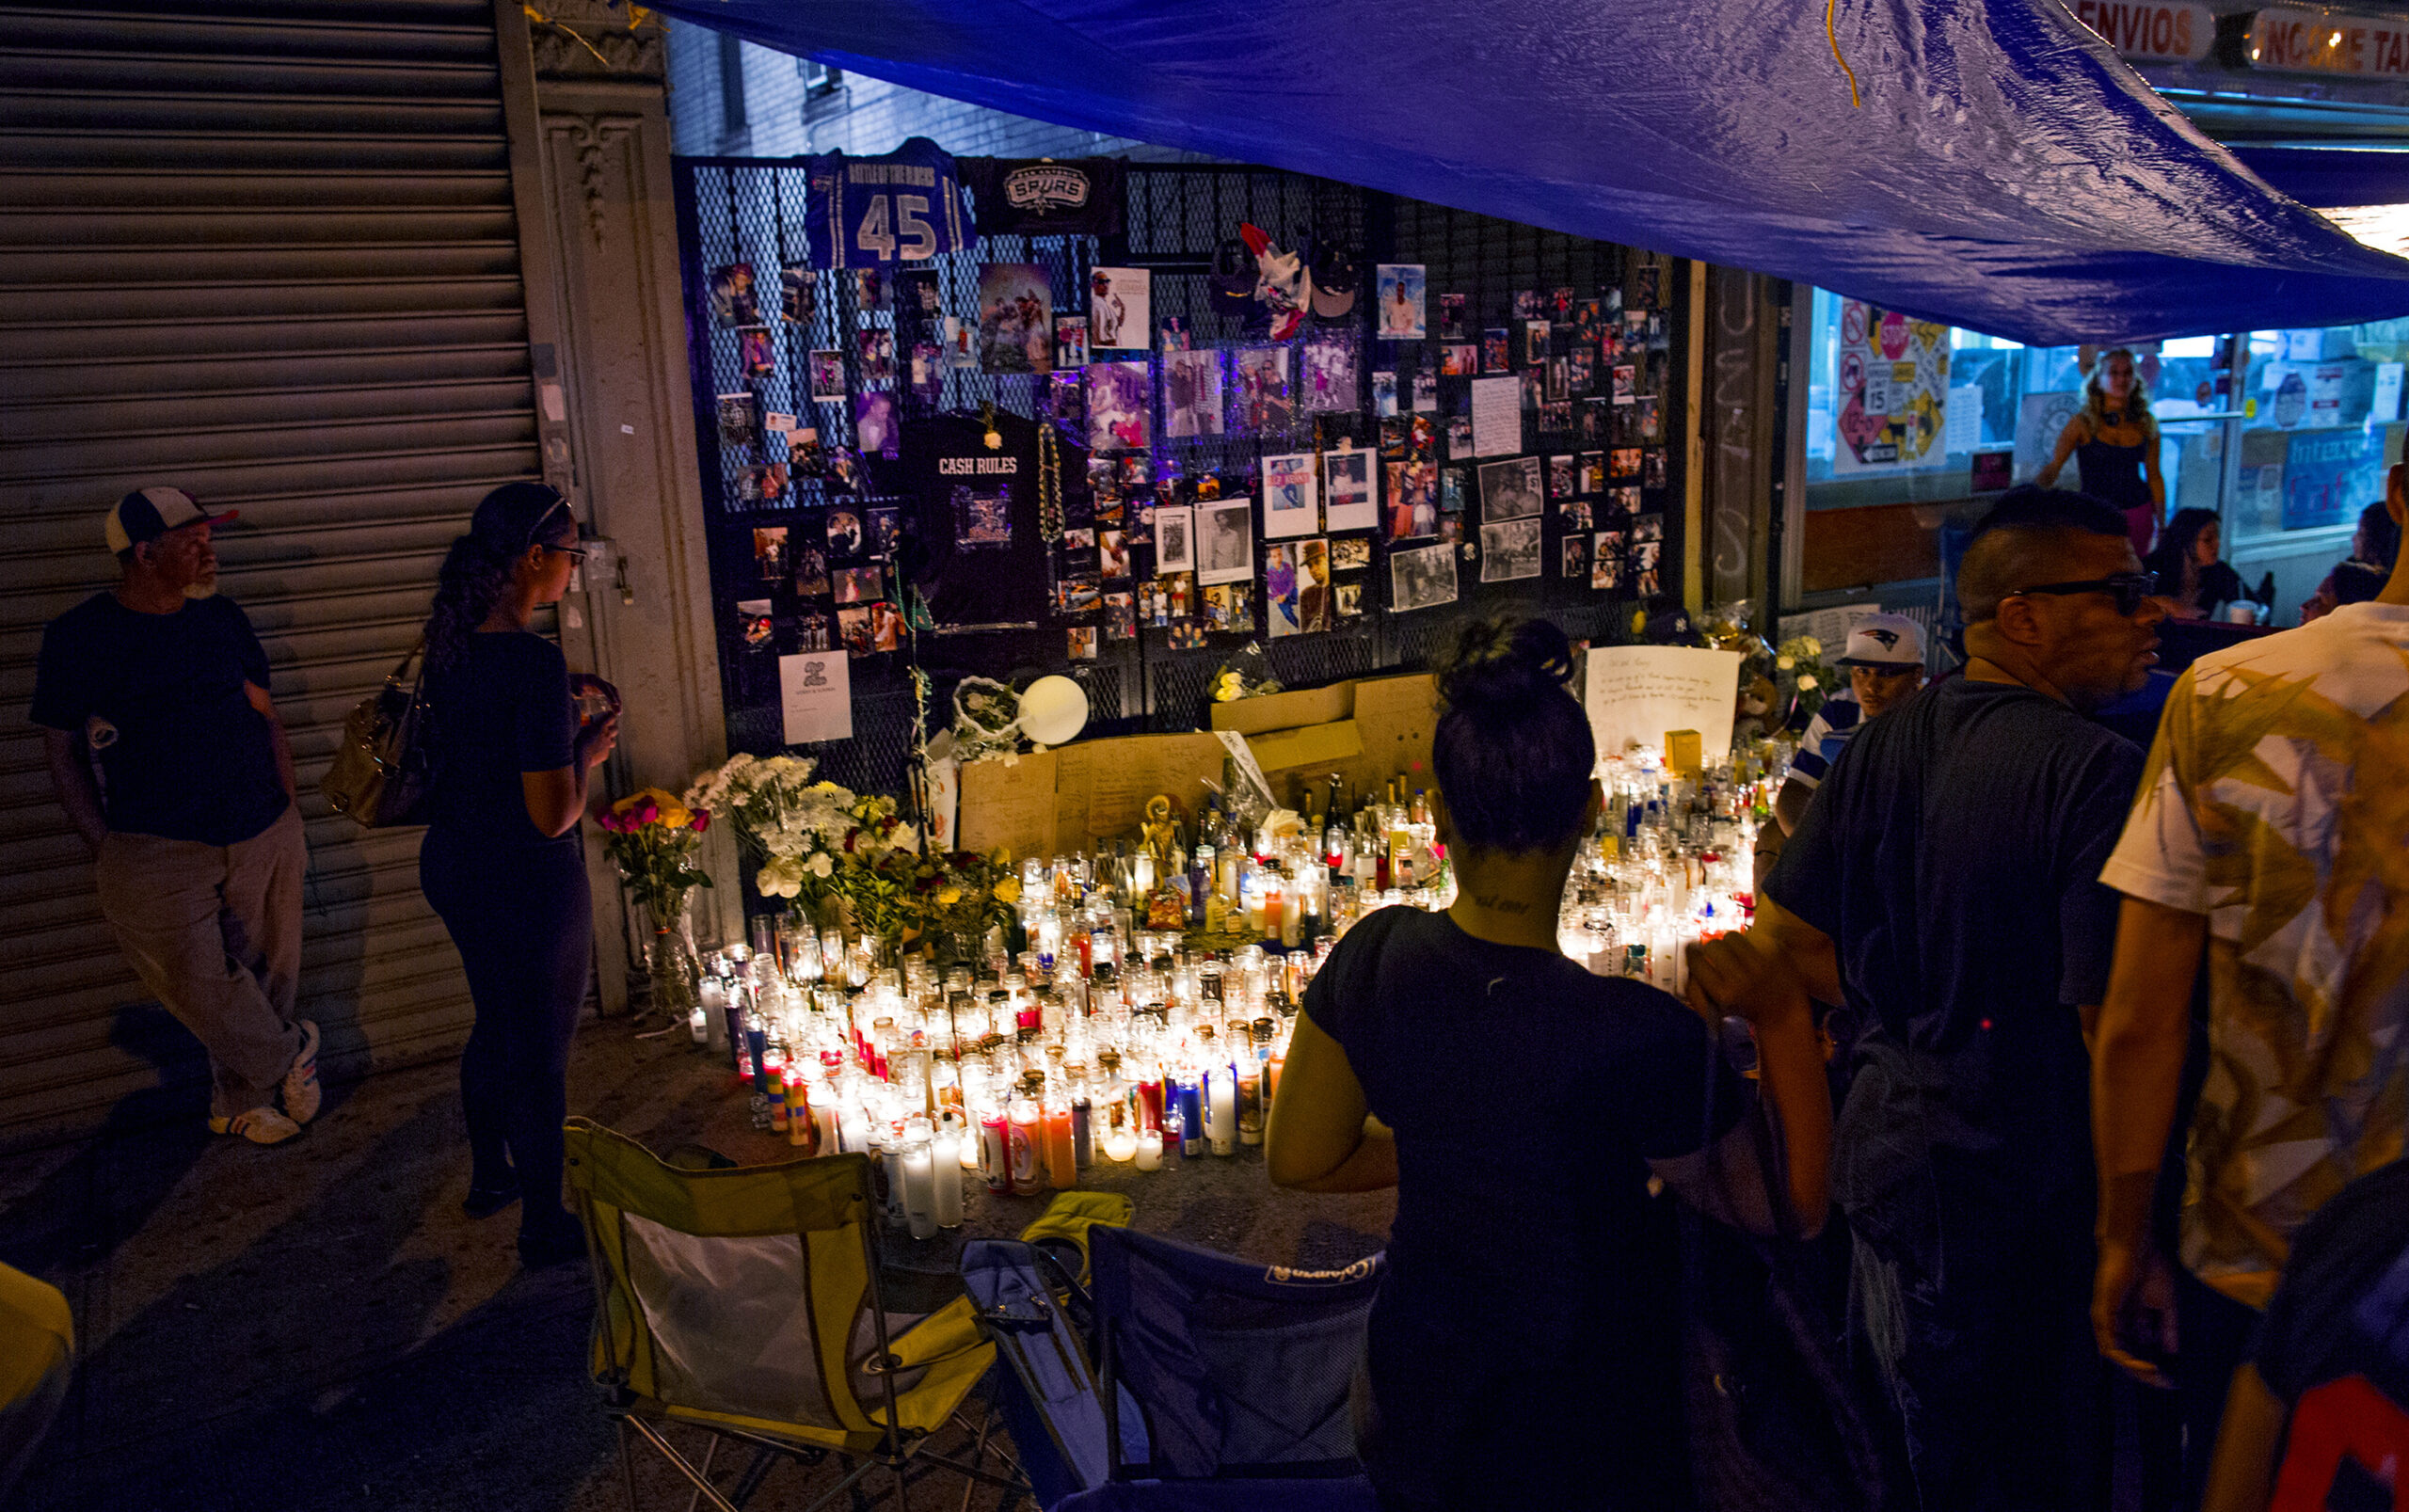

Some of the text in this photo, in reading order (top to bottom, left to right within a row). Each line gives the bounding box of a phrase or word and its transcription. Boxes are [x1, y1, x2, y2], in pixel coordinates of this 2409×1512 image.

[2078, 1, 2192, 55] ENVIOS
[2374, 29, 2409, 72] TA
[1014, 179, 1080, 197] SPURS
[857, 194, 936, 261] 45
[939, 456, 1017, 475] CASH RULES
